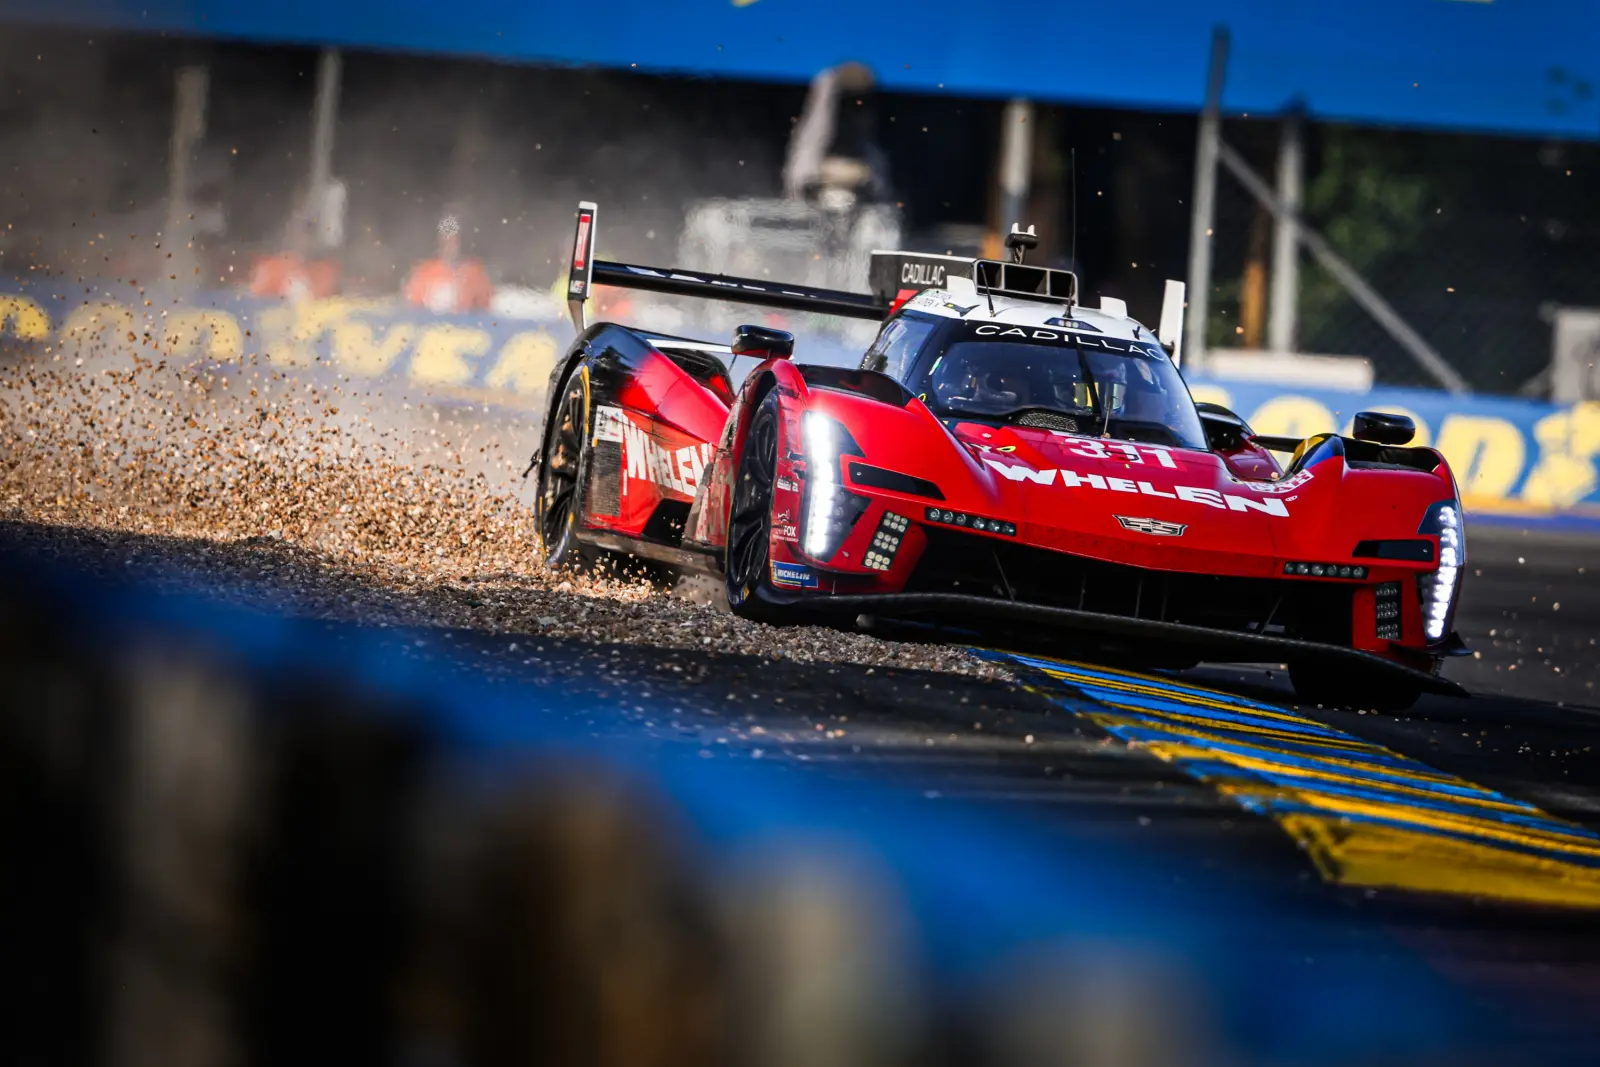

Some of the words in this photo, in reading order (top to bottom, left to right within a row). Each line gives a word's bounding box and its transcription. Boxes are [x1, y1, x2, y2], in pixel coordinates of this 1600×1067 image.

[901, 262, 945, 286] CADILLAC
[975, 325, 1165, 361] CADILLAC
[622, 414, 712, 498] WHELEN
[1065, 437, 1178, 469] 311
